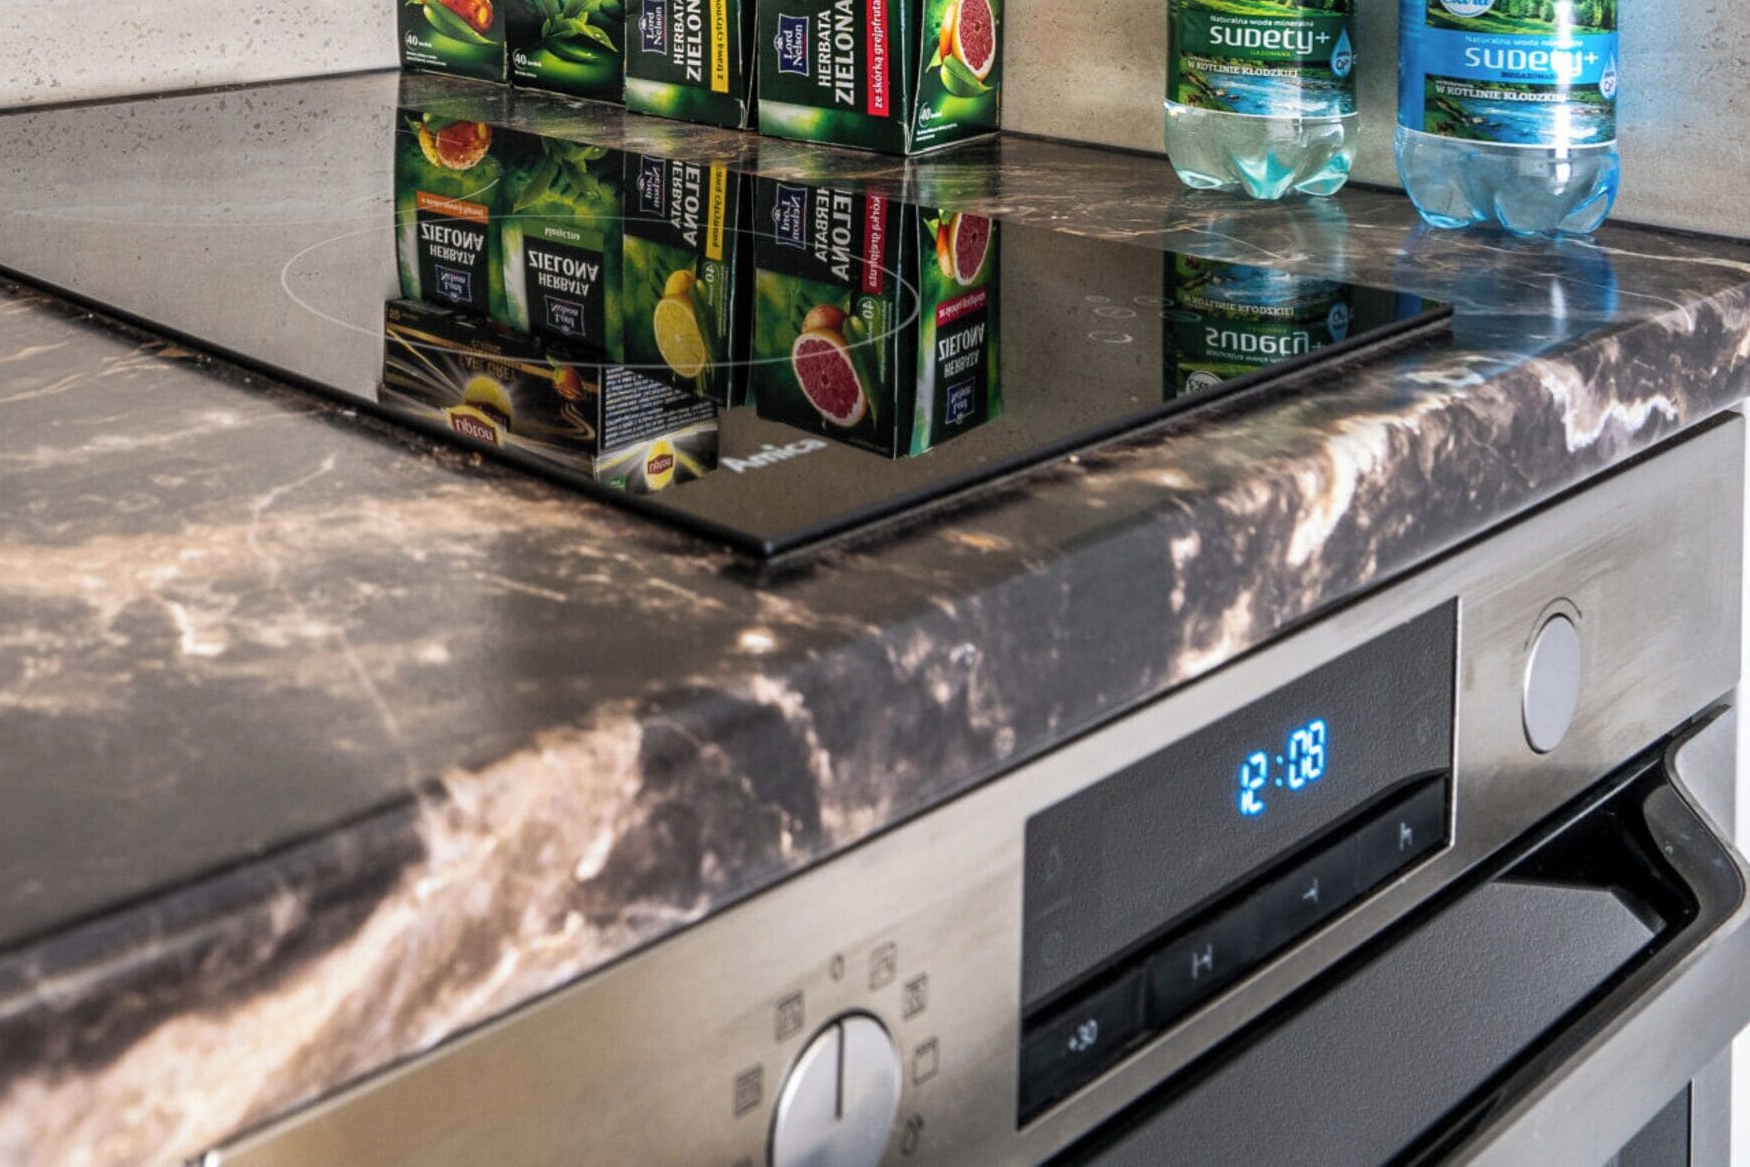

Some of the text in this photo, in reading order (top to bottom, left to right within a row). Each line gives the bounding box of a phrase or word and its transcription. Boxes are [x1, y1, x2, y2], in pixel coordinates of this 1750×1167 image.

[646, 12, 655, 39] Lord
[654, 6, 663, 45] Nelson
[1250, 17, 1272, 26] woda
[716, 43, 724, 72] trawą
[784, 30, 793, 60] Lord
[793, 24, 803, 66] Nelson
[818, 10, 831, 87] HERBATA
[872, 0, 883, 108] ze skórką grejpfruta
[1196, 62, 1240, 74] KOTLINIE
[1242, 64, 1299, 78] KŁODZKIEJ
[1446, 87, 1501, 100] KOTLINIE
[1241, 719, 1326, 815] 12:08
